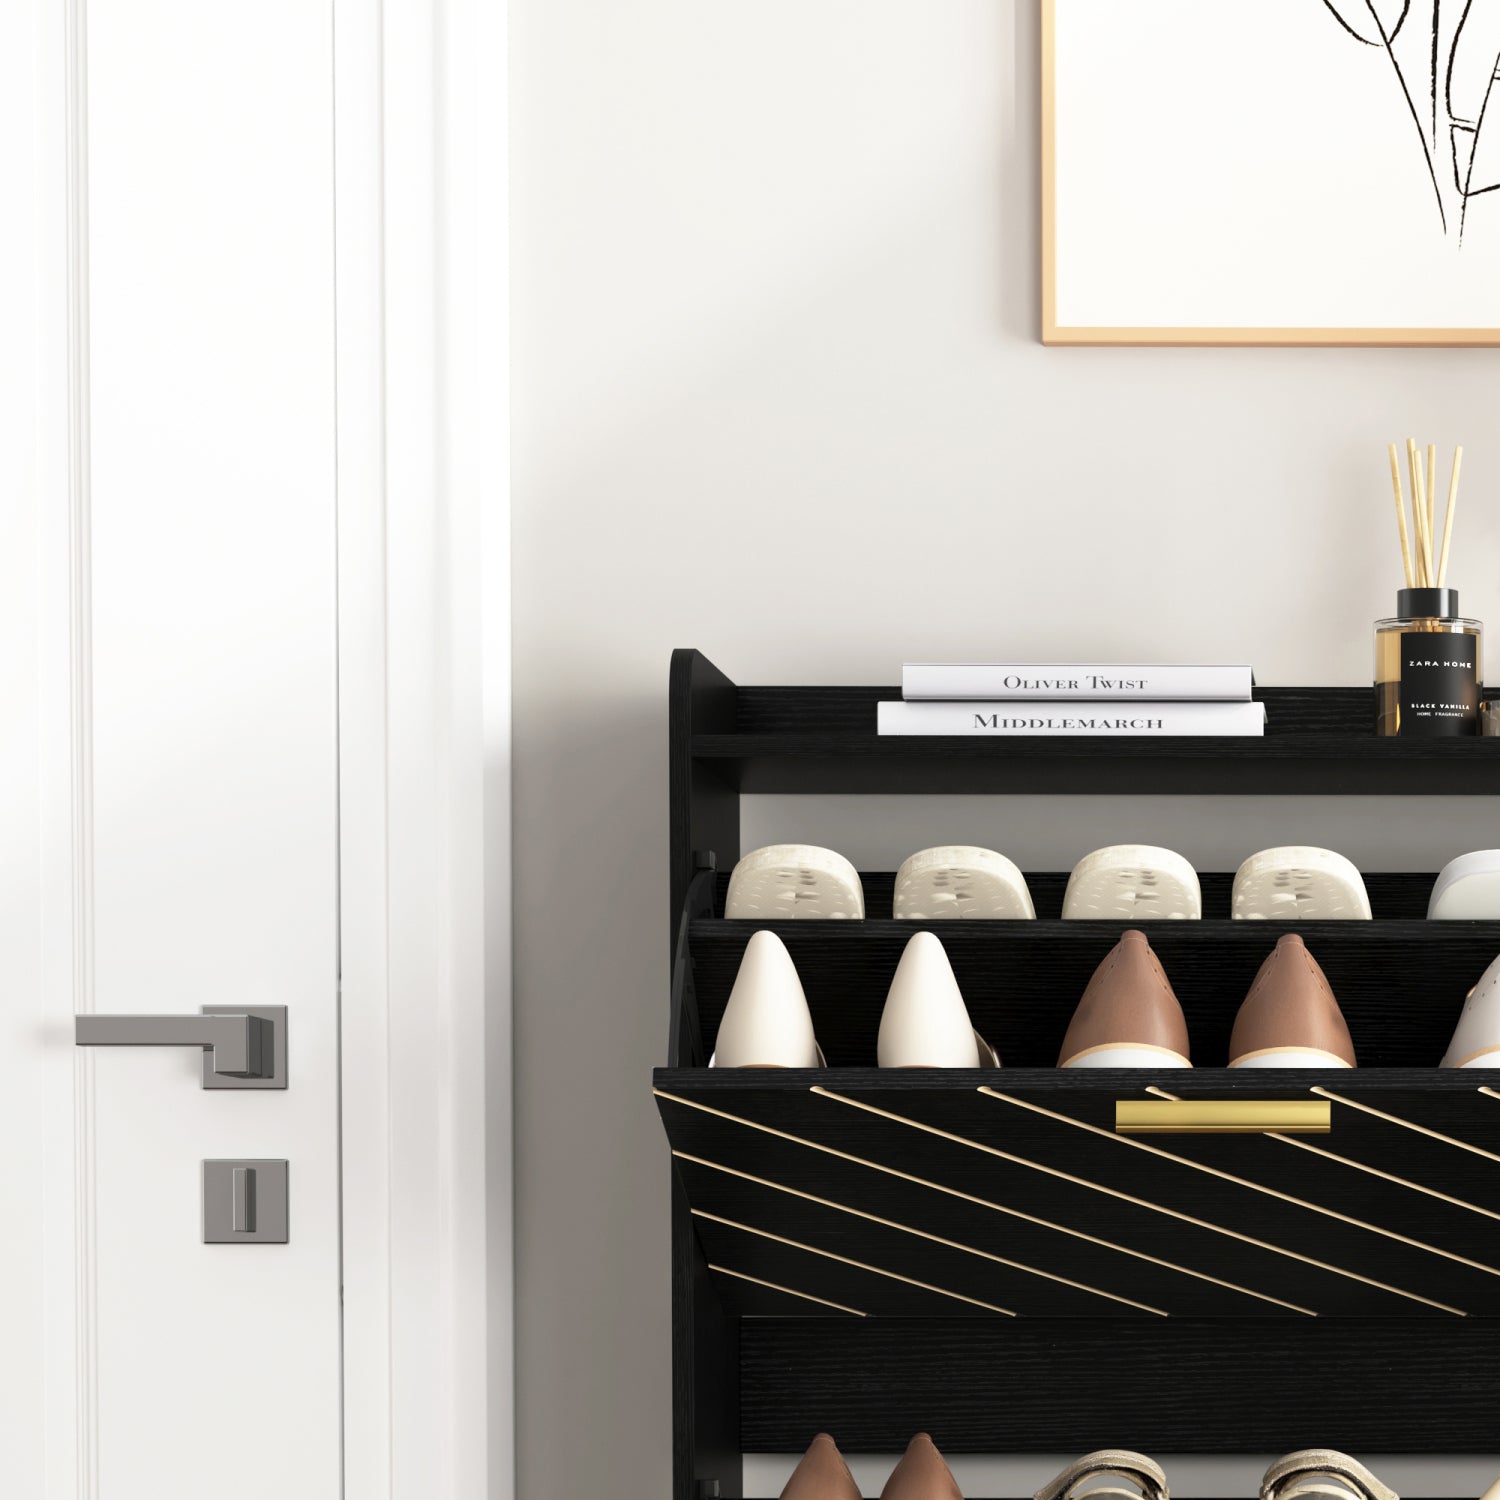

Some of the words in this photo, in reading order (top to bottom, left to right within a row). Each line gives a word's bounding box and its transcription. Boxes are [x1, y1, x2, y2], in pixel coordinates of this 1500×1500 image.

[1443, 661, 1472, 669] HOME
[1003, 675, 1079, 689] OLIVER
[1086, 675, 1148, 689] TWIST
[973, 714, 1164, 729] MIDDLEMARCH
